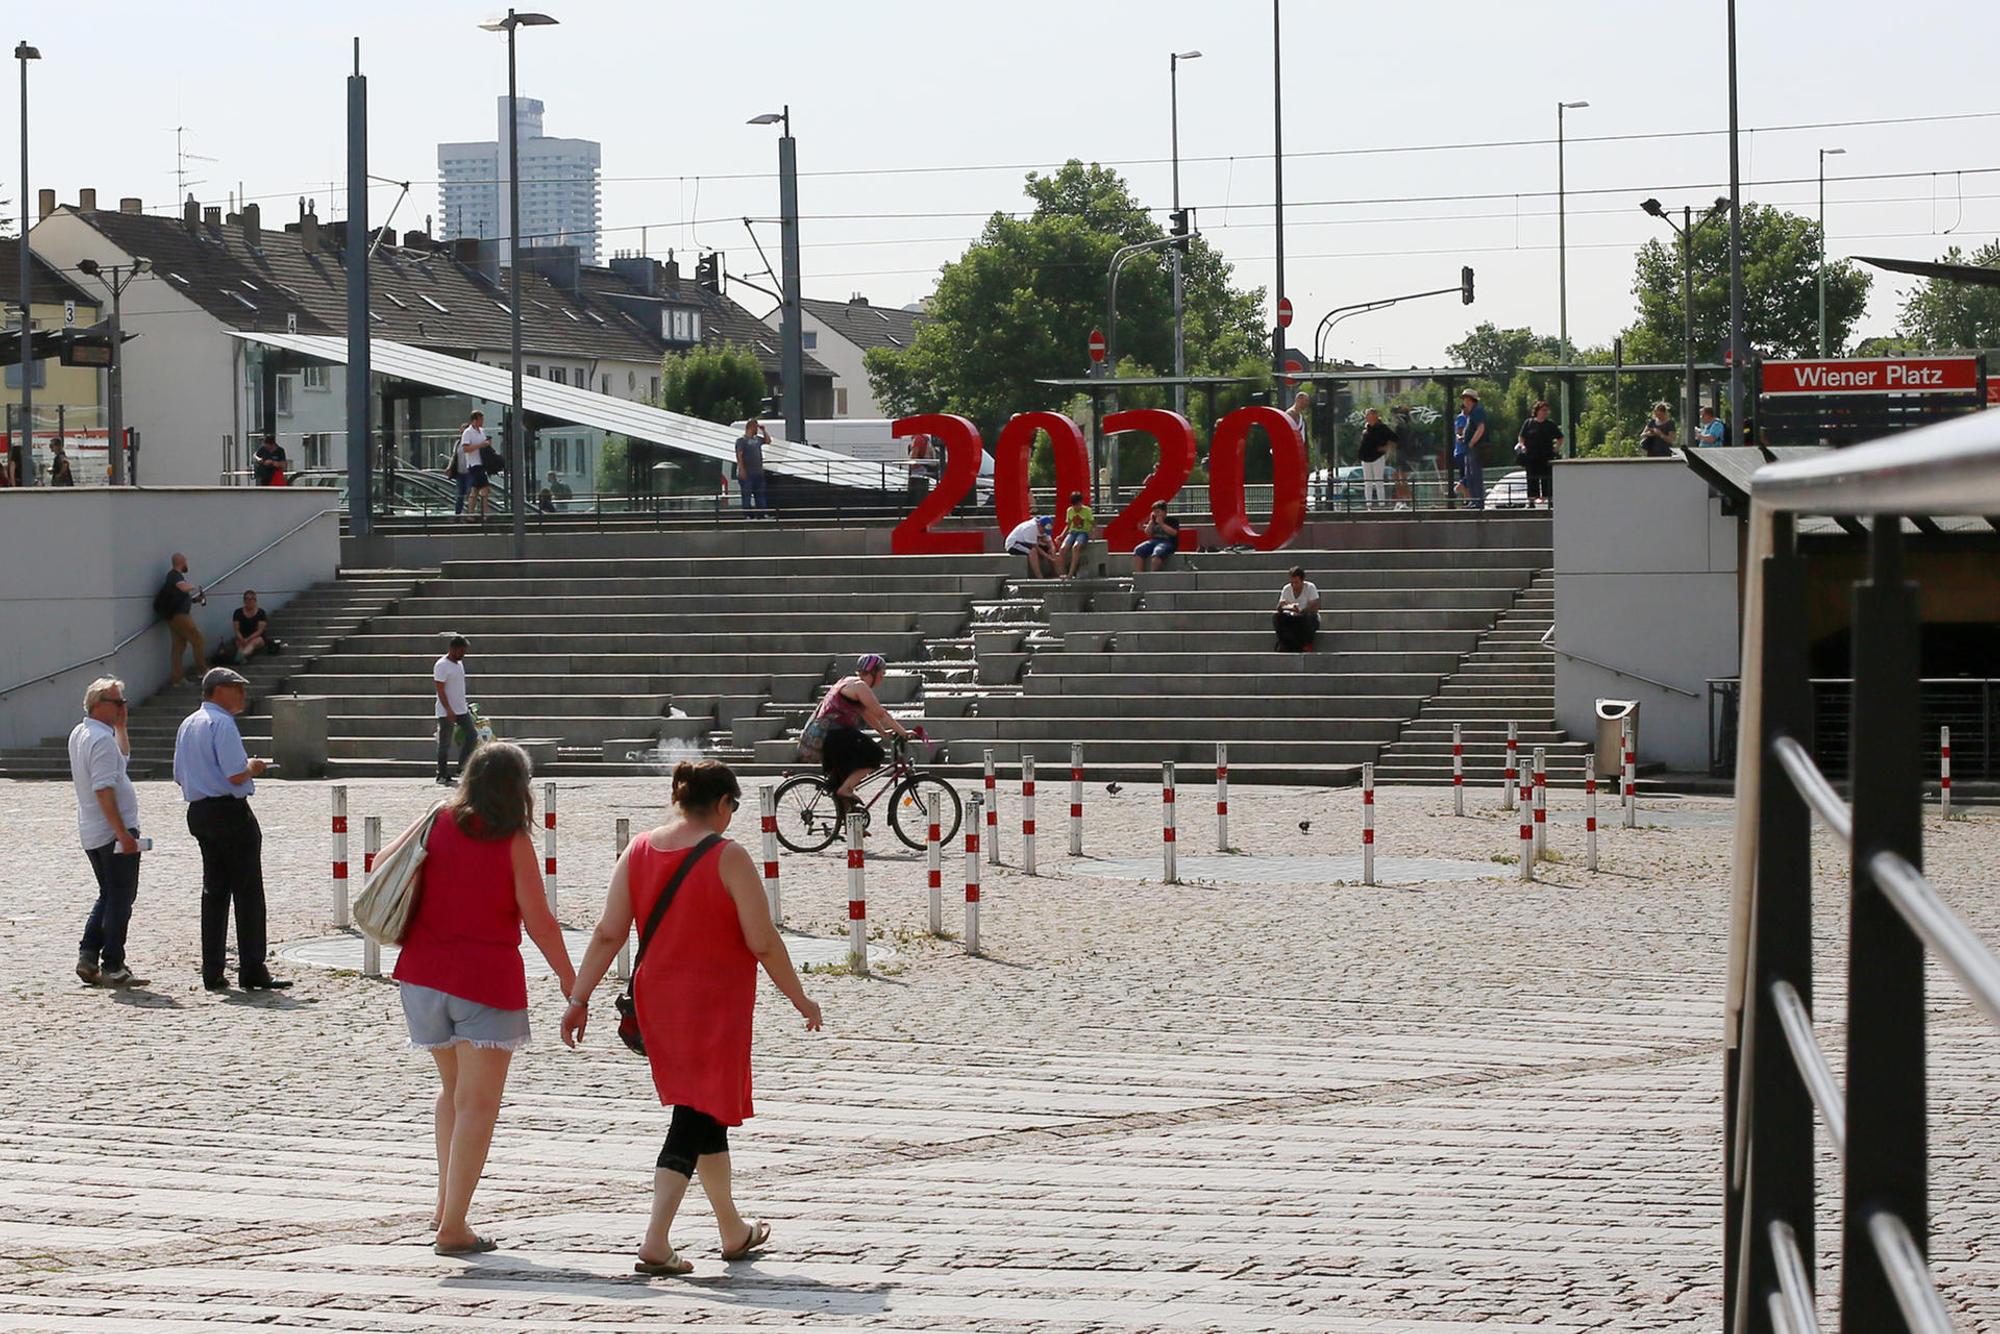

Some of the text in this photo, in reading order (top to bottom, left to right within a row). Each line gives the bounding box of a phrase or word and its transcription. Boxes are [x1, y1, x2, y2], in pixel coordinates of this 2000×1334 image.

[66, 307, 73, 322] 3
[289, 319, 296, 334] 4
[1794, 365, 1943, 387] Wiener Platz
[892, 405, 1307, 553] 2020
